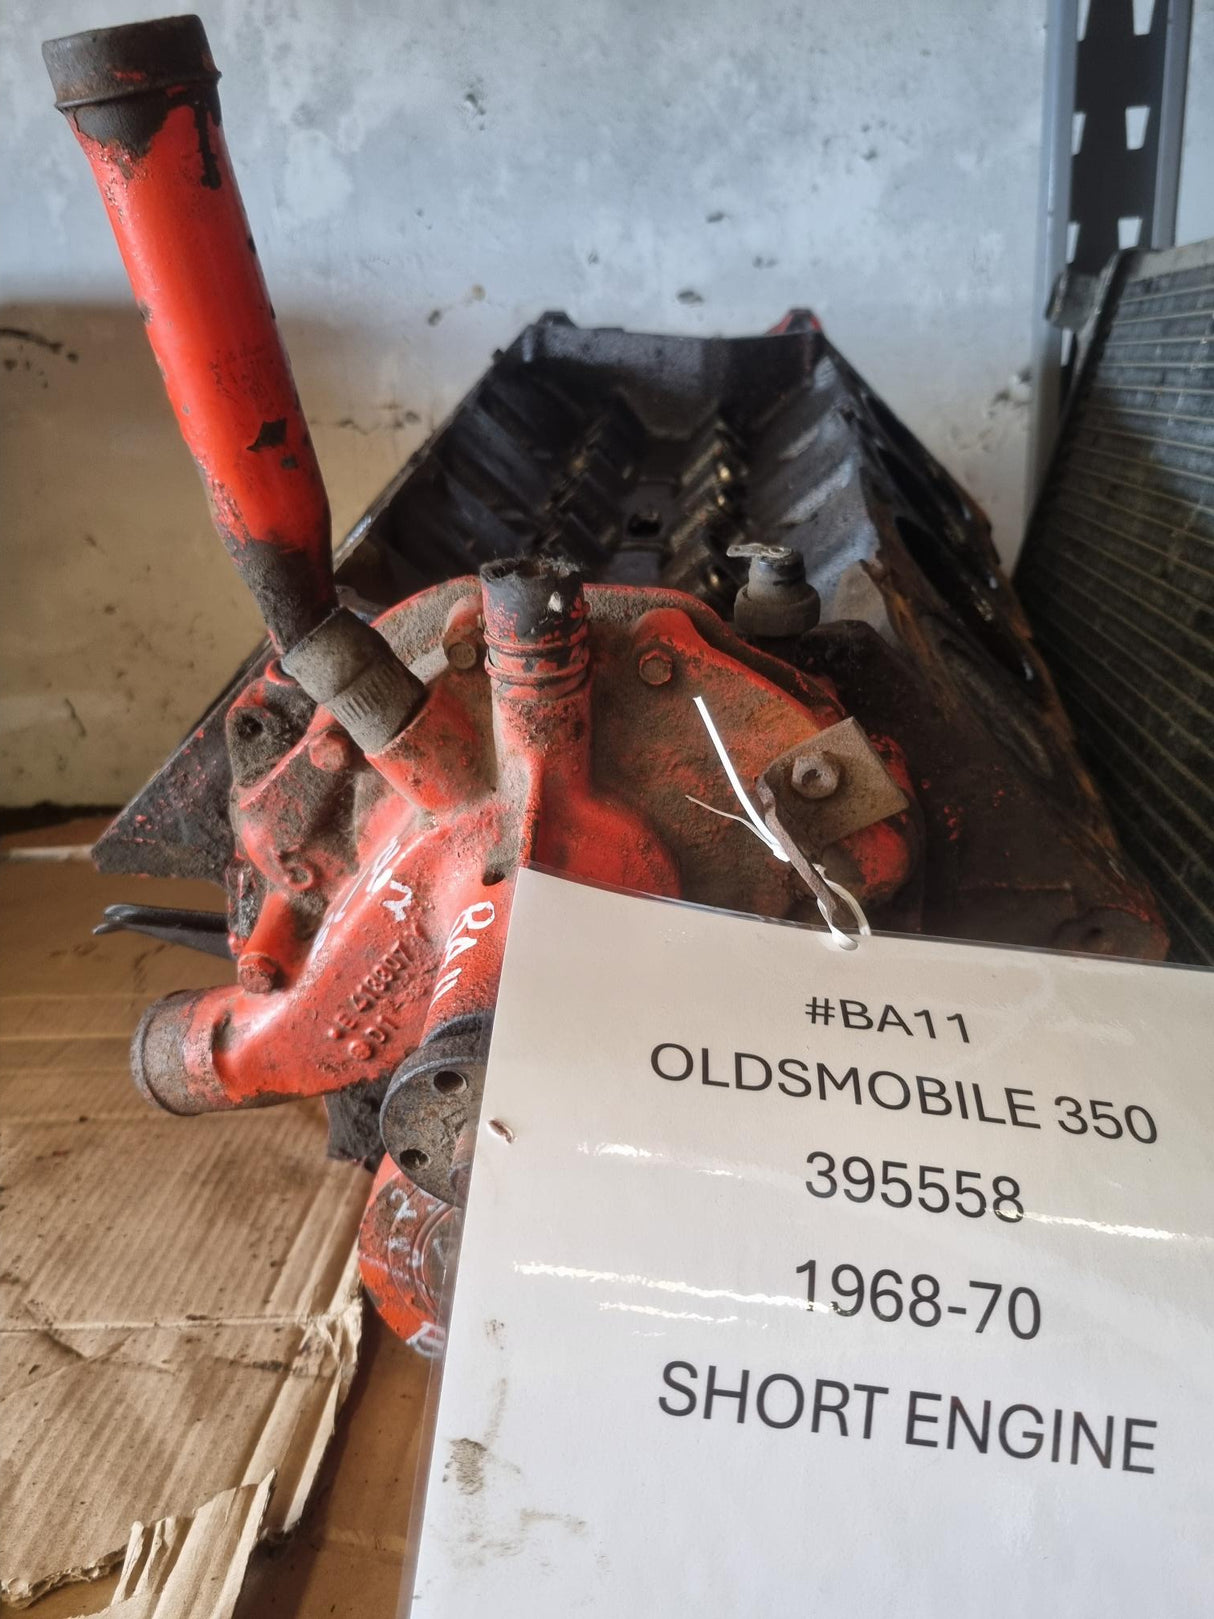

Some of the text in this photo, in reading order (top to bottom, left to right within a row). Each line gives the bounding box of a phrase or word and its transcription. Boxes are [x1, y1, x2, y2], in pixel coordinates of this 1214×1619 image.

[805, 996, 970, 1044] #BA11
[650, 1042, 1158, 1145] OLDSMOBILE 350
[805, 1151, 1025, 1224] 395558
[795, 1259, 1042, 1340] 1968-70
[658, 1360, 1158, 1474] SHORT ENGINE
